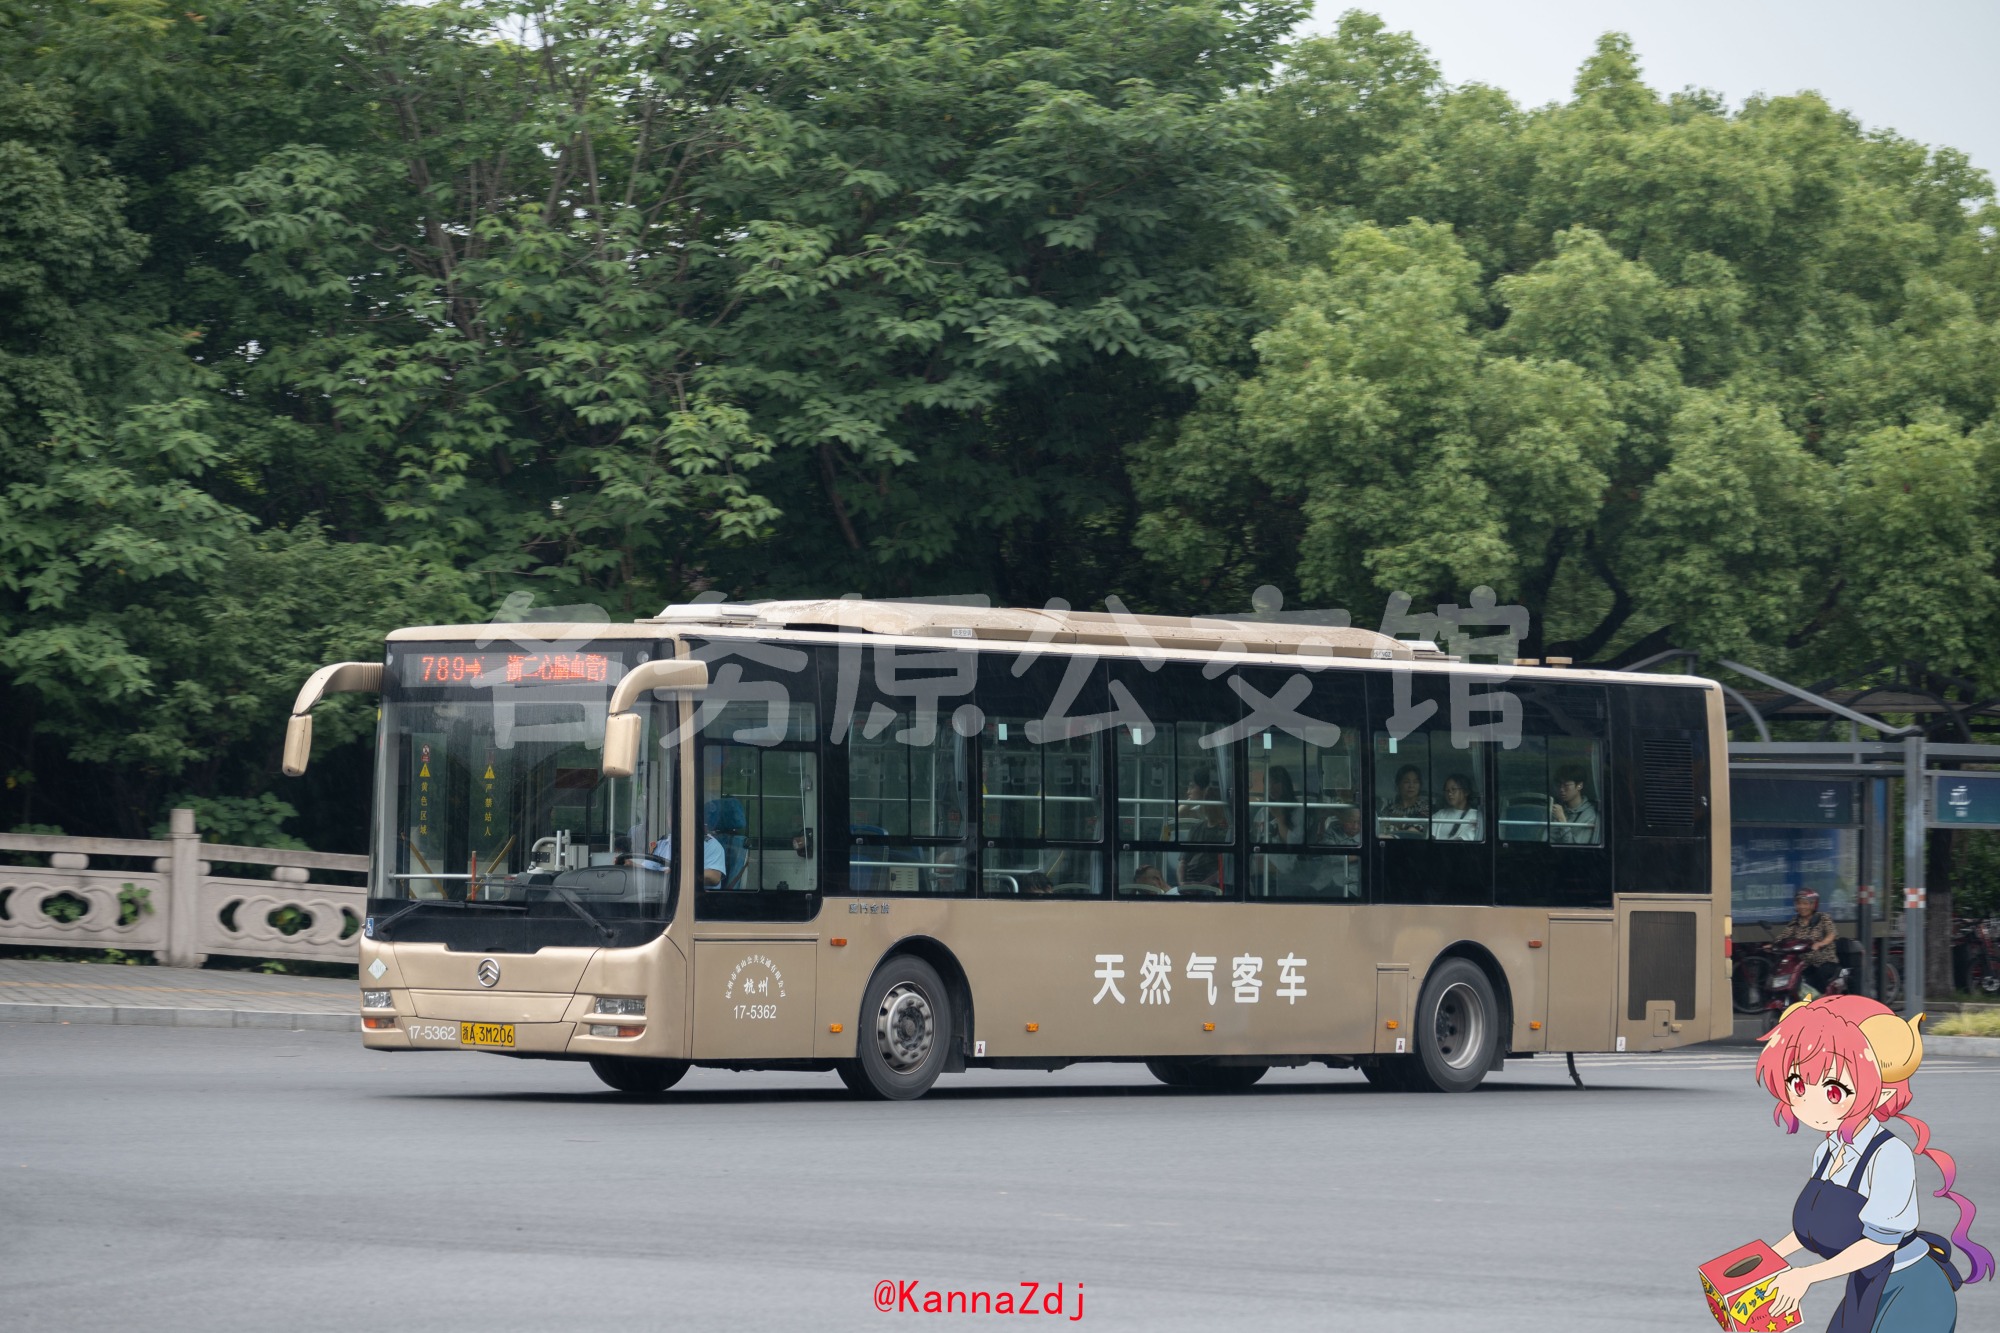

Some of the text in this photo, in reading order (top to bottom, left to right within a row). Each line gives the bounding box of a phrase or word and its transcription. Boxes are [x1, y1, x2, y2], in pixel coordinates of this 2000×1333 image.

[422, 656, 464, 681] 789
[419, 781, 428, 836] 黄色区域
[484, 783, 493, 837] 严禁站人
[743, 976, 769, 997] 杭州
[1092, 951, 1308, 1006] 天然气客车
[733, 1004, 777, 1019] 17-5362
[408, 1025, 456, 1040] 17-5362
